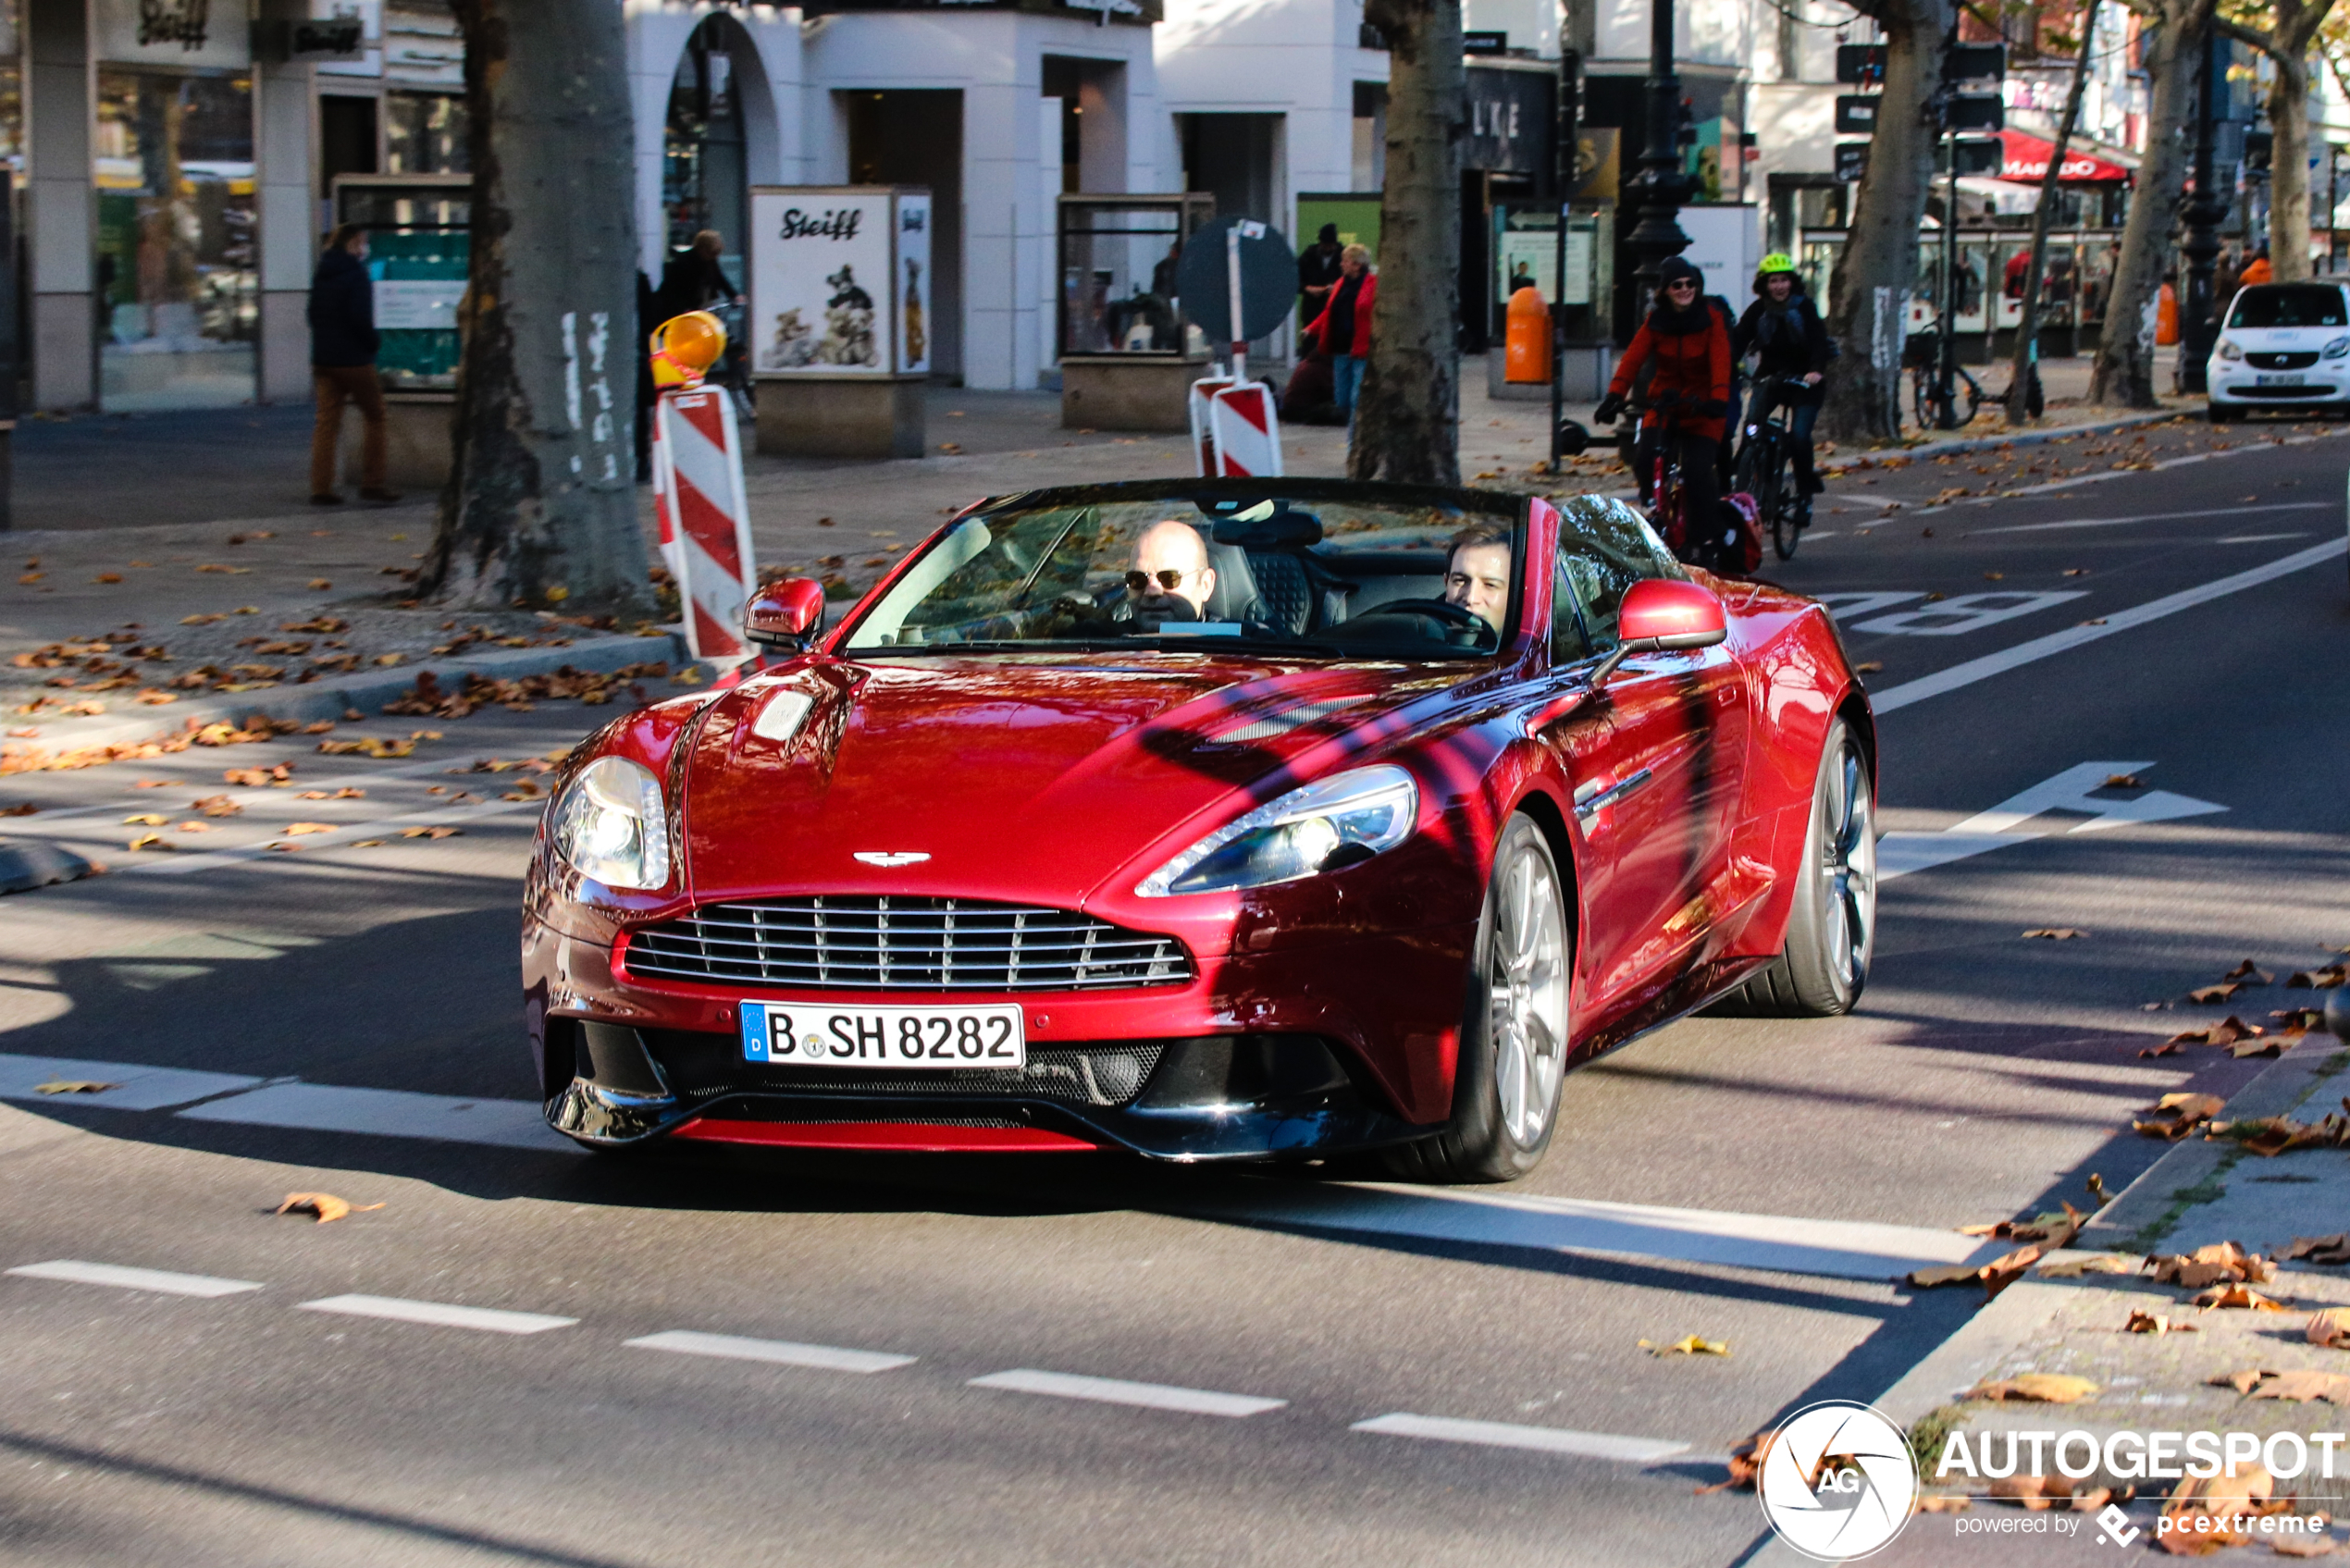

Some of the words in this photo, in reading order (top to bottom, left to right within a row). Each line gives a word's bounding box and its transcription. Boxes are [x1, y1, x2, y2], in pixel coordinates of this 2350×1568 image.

[2002, 160, 2096, 177] MARDO
[779, 208, 861, 241] Steiff
[750, 1037, 761, 1052] D
[769, 1012, 797, 1055] B
[829, 1016, 886, 1058] SH
[898, 1016, 1015, 1059] 8282
